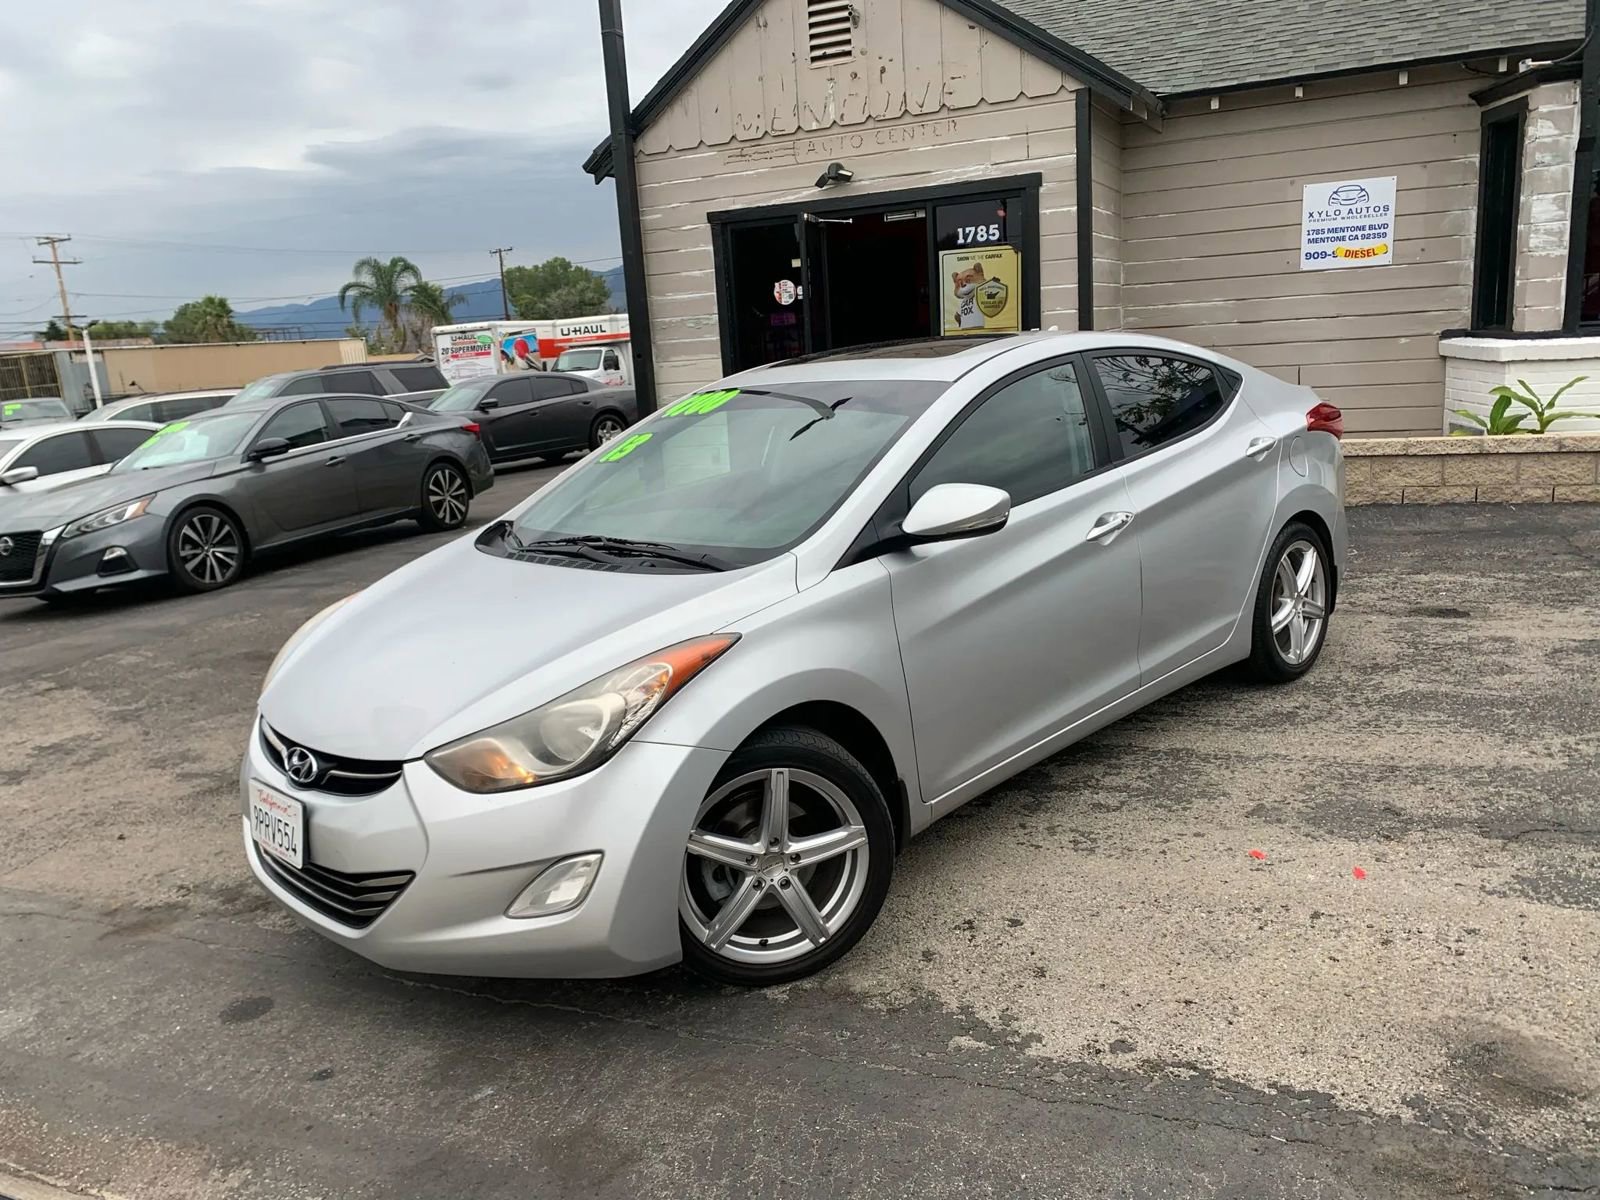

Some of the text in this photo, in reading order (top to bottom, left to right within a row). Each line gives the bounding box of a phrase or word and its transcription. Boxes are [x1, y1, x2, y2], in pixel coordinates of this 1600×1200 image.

[874, 119, 960, 146] CENTER
[1308, 204, 1390, 219] XYLO AUTOS
[957, 223, 1000, 245] 1785
[1306, 222, 1389, 236] 1785 MENTONE BLVD
[1307, 231, 1388, 244] MENTONE CA 92359
[1343, 248, 1379, 259] DIESEL
[561, 324, 606, 337] U-HAUL
[450, 343, 491, 354] SUPERMOVER
[253, 805, 298, 857] 9PRV554
